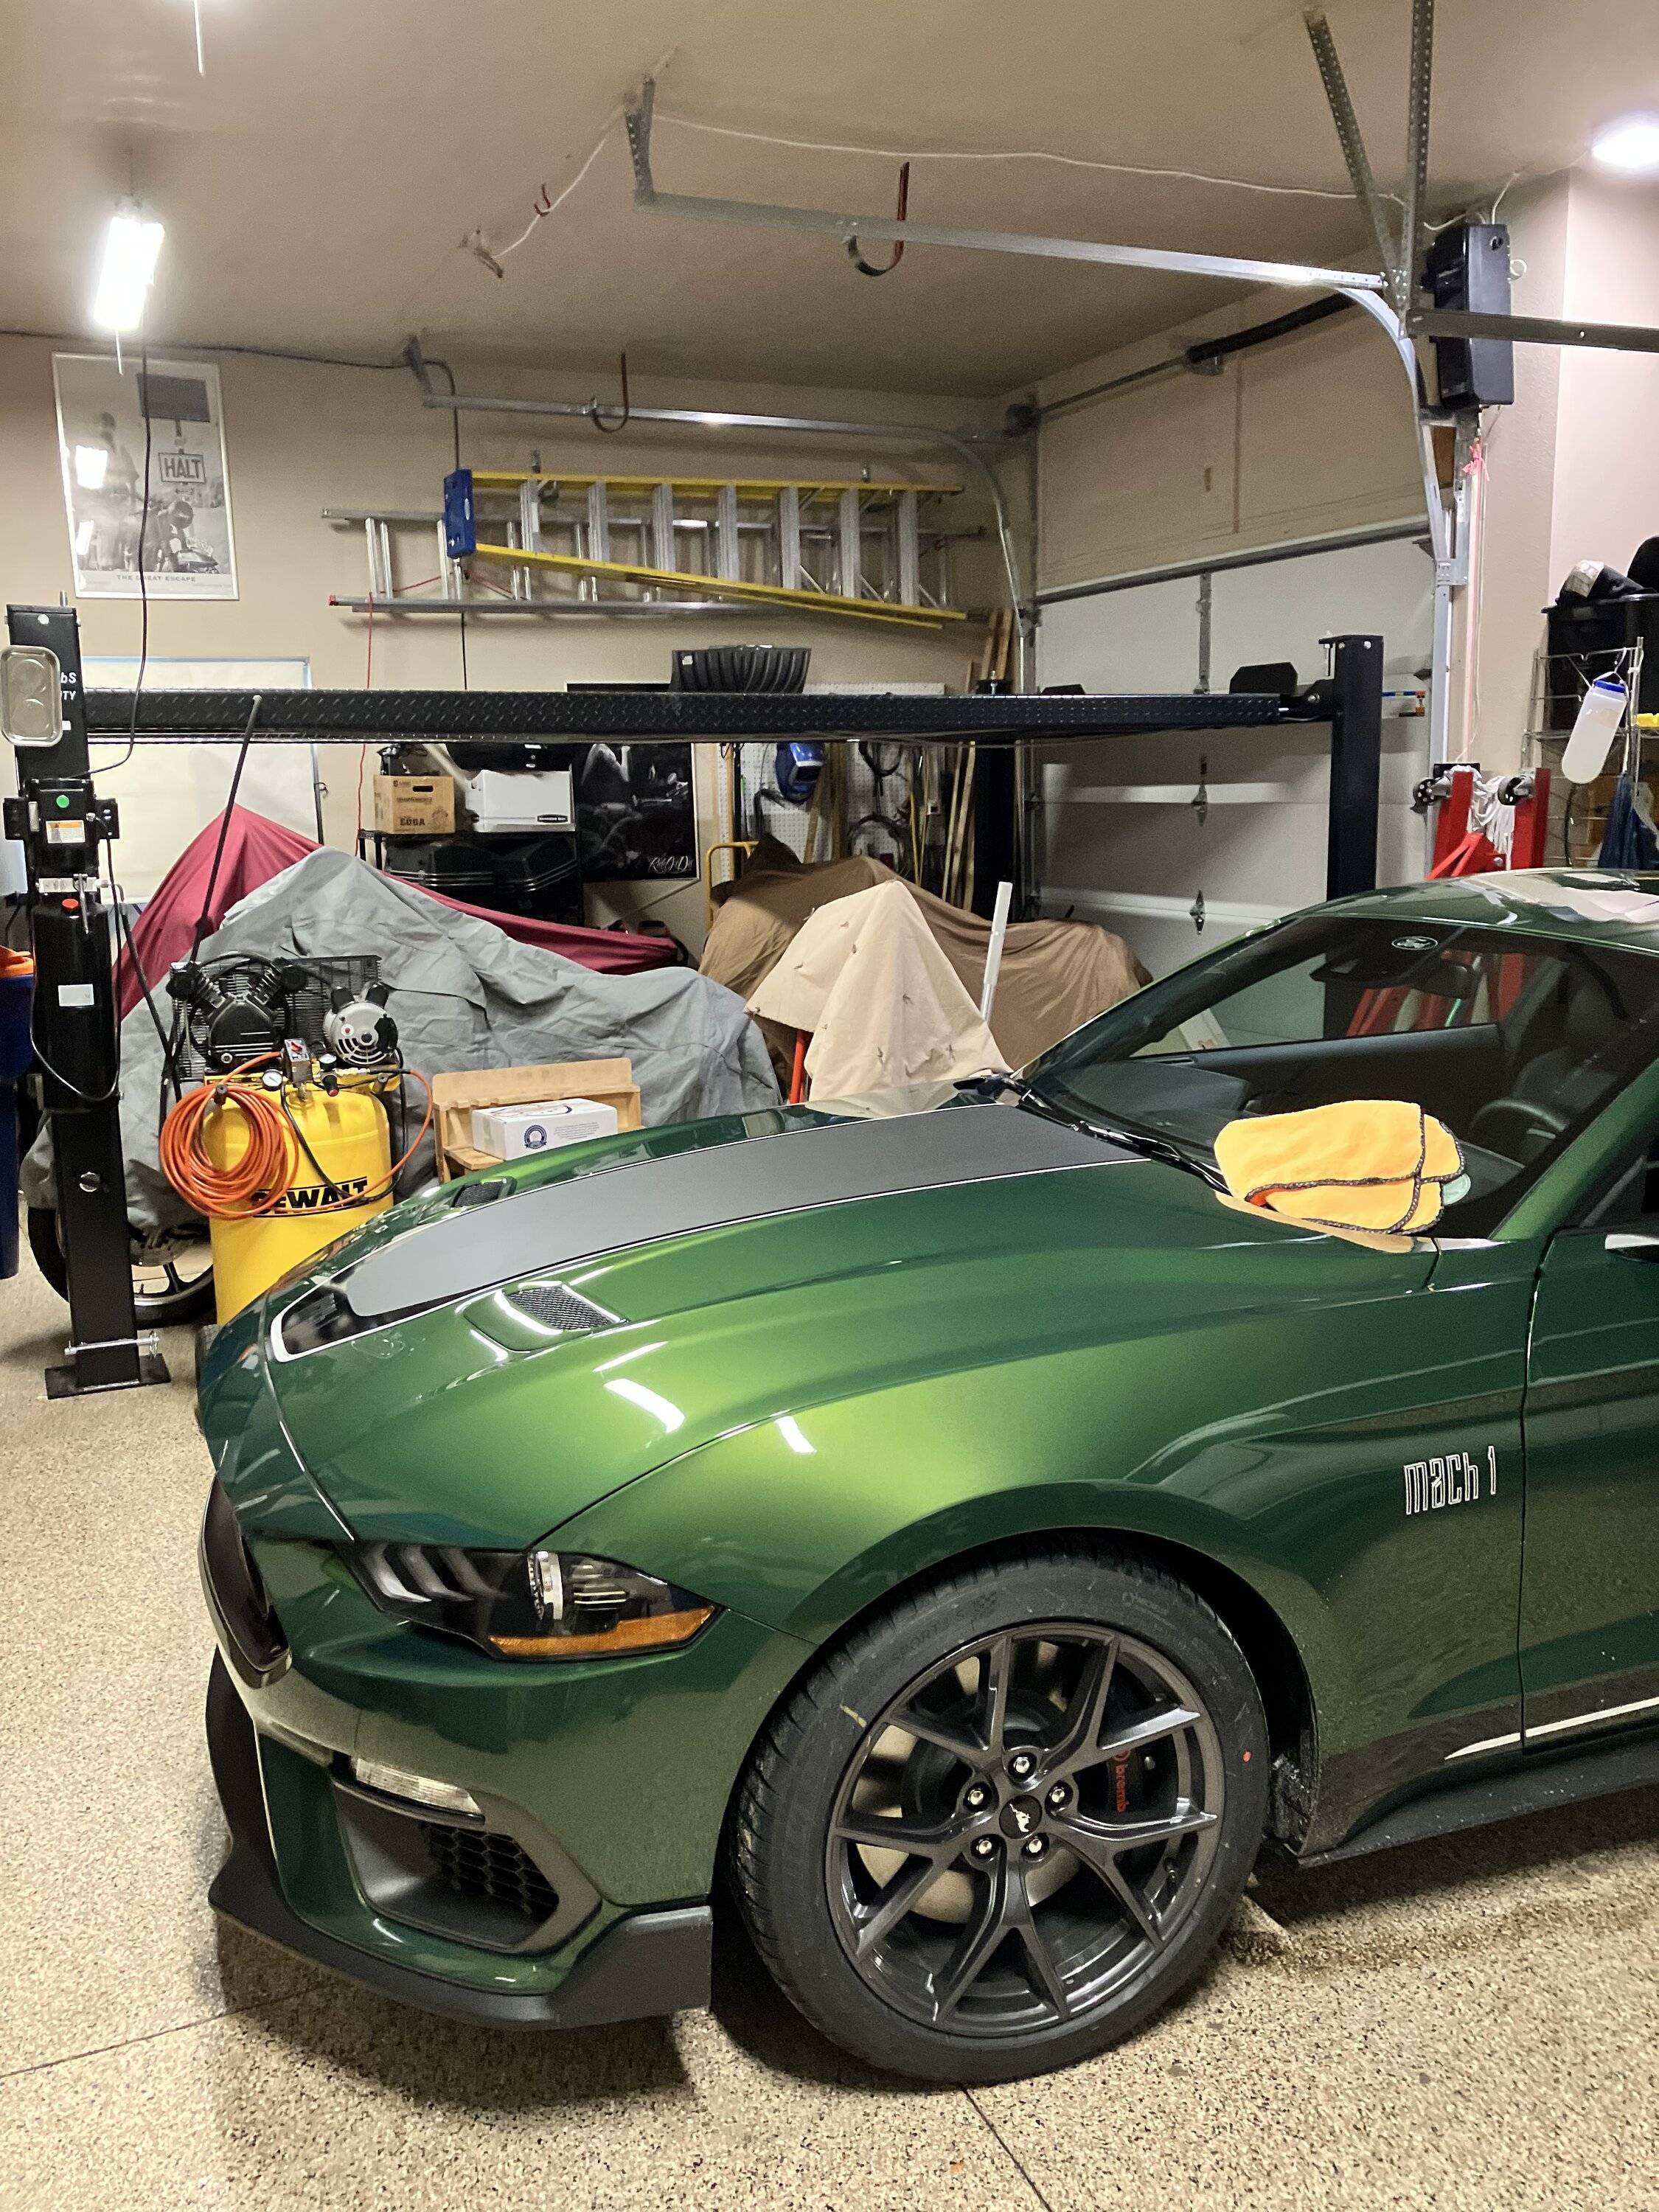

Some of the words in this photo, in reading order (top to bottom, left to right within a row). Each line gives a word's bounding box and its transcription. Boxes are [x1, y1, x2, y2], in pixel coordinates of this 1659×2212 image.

[164, 457, 201, 479] HALT
[60, 672, 77, 684] bS
[1487, 1445, 1496, 1495] 1
[1116, 1763, 1130, 1813] bremb
